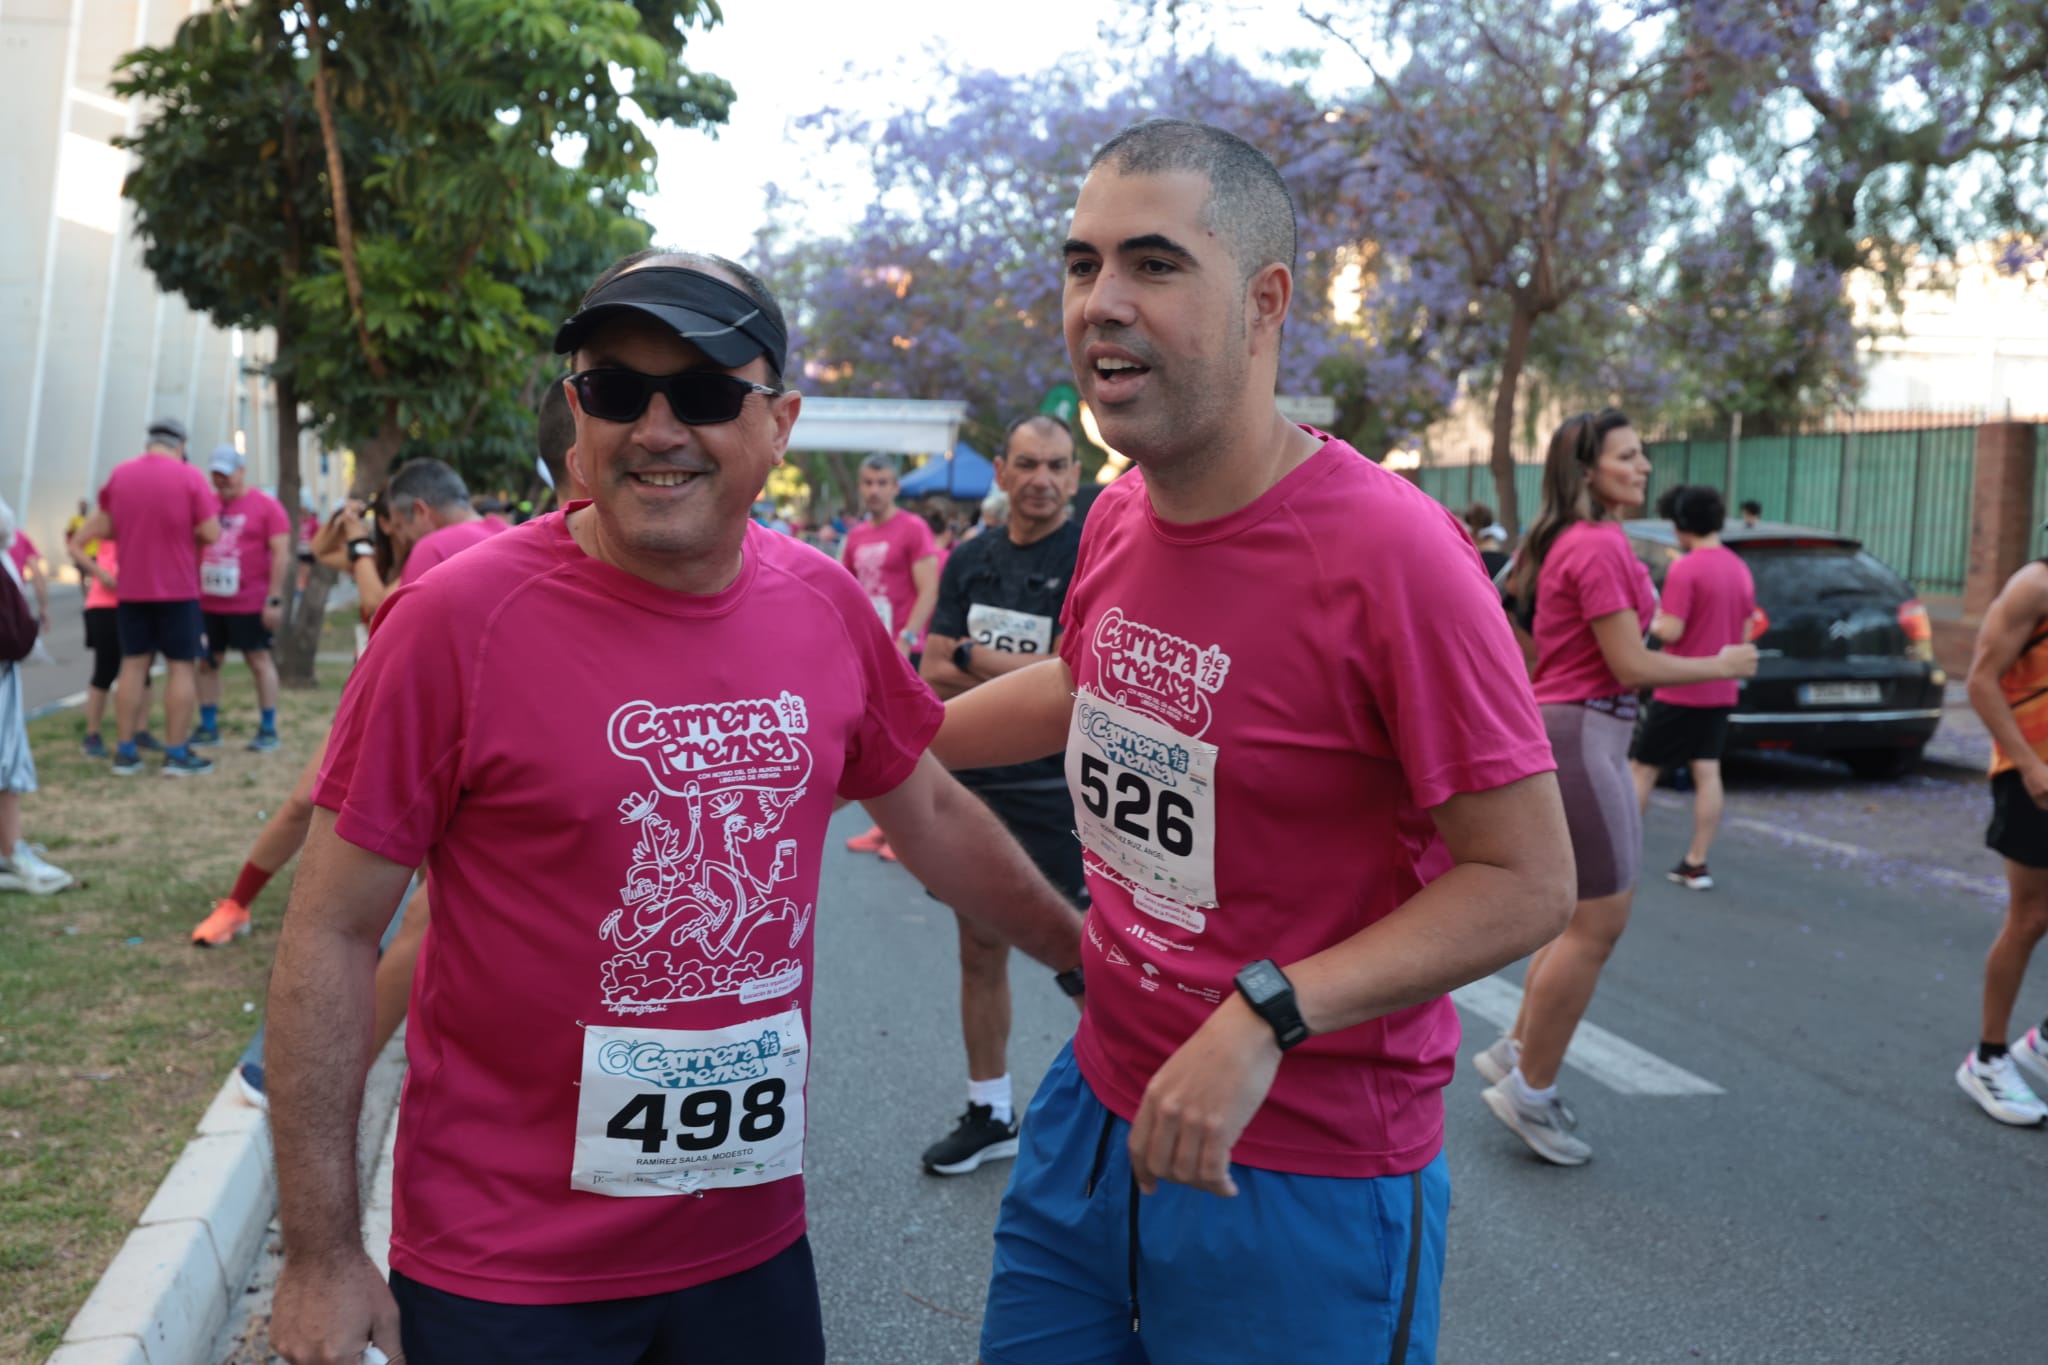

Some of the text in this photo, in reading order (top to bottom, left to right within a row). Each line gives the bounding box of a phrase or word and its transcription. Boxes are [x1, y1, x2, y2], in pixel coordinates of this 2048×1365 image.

[1098, 617, 1225, 677] Carrera de
[1107, 653, 1196, 712] Prensa
[1202, 665, 1220, 688] la
[620, 697, 801, 747] Carrera de
[784, 710, 806, 729] la
[1091, 717, 1171, 764] Carrera
[1171, 745, 1187, 759] de
[658, 730, 796, 775] Prensa
[1104, 742, 1176, 786] Prensa
[1172, 757, 1186, 770] la
[1080, 751, 1195, 857] 526
[633, 1041, 760, 1072] Carrera
[760, 1031, 777, 1044] de
[762, 1043, 778, 1055] la
[656, 1058, 767, 1087] Prensa
[606, 1077, 786, 1153] 498
[712, 1147, 754, 1160] MODESTO
